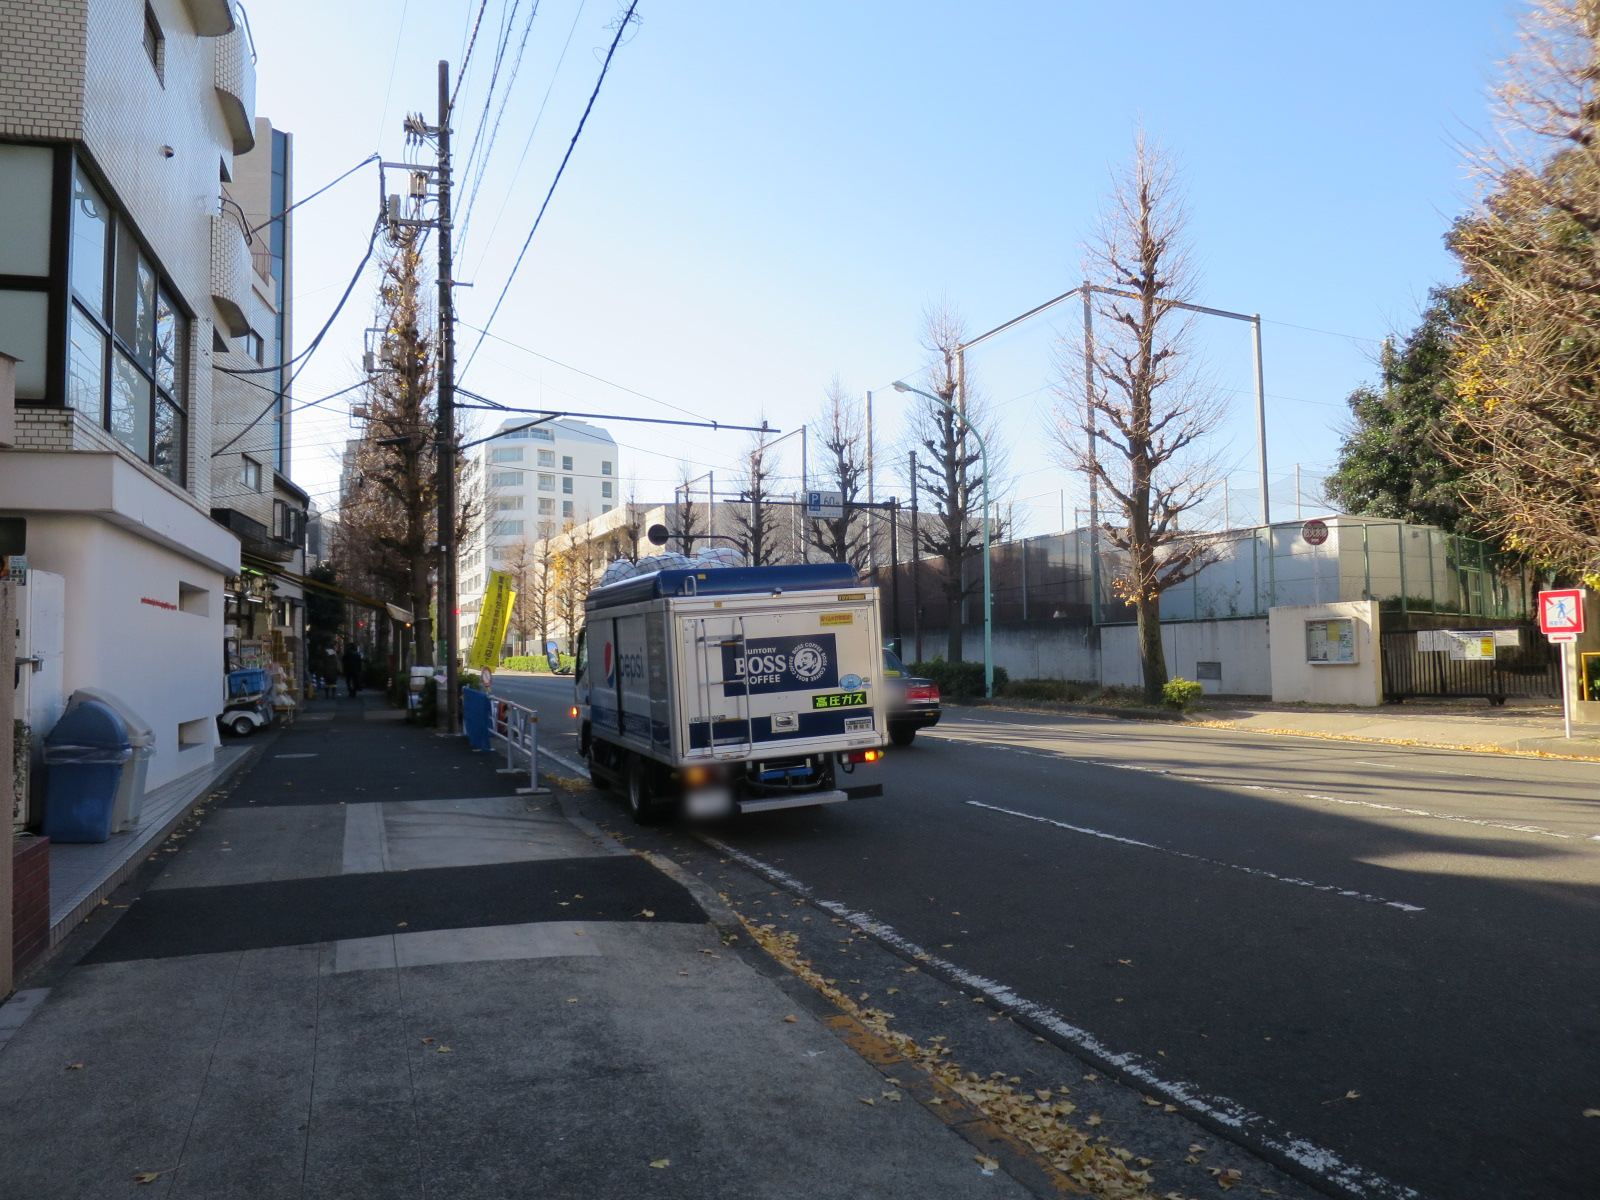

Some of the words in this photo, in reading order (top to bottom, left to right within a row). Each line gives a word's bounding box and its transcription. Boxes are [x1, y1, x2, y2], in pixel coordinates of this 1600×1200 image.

[812, 494, 819, 505] P
[791, 643, 804, 655] BOSS
[804, 642, 823, 653] COFFEE
[734, 654, 787, 676] BOSS
[789, 656, 797, 675] COFFEE
[810, 667, 826, 683] COFFEE
[815, 693, 864, 708] 高圧ガス
